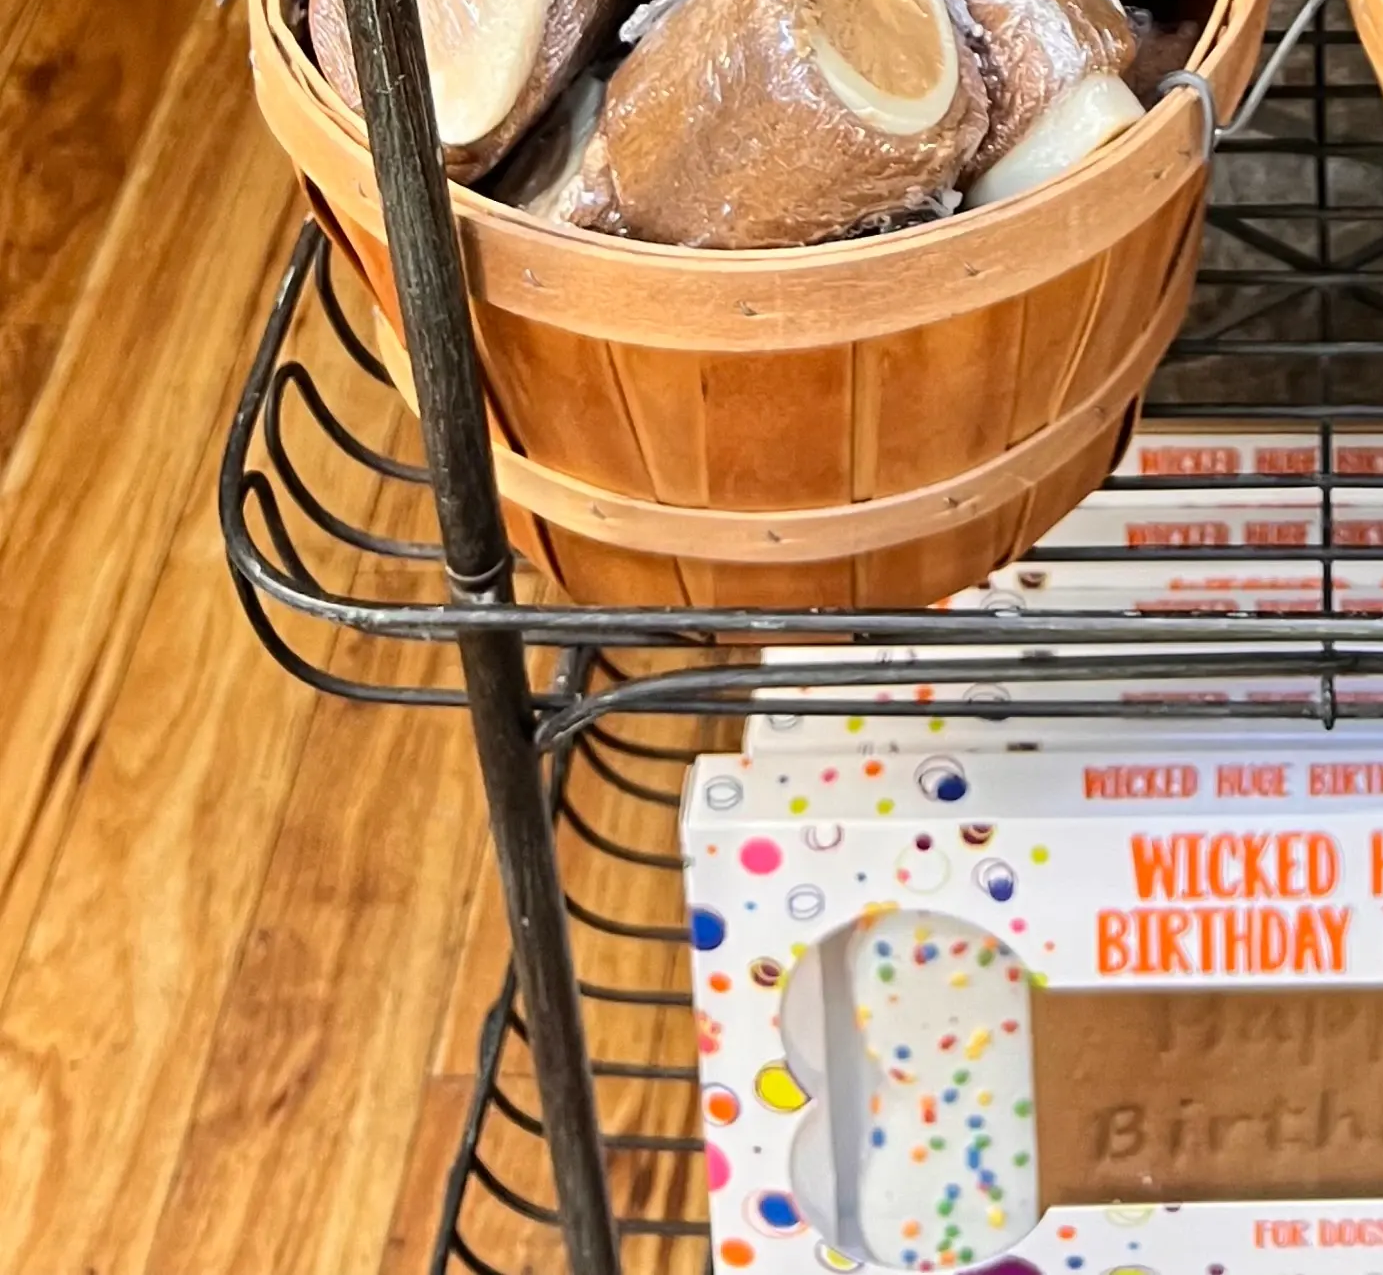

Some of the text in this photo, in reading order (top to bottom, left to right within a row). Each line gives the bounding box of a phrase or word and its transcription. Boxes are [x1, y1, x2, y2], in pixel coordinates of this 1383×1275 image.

[1083, 764, 1199, 799] WICKED
[1215, 762, 1292, 798] HUGE
[1129, 830, 1344, 901] WICKED
[1094, 903, 1354, 978] BIRTHDAY
[1253, 1219, 1311, 1249] FOR
